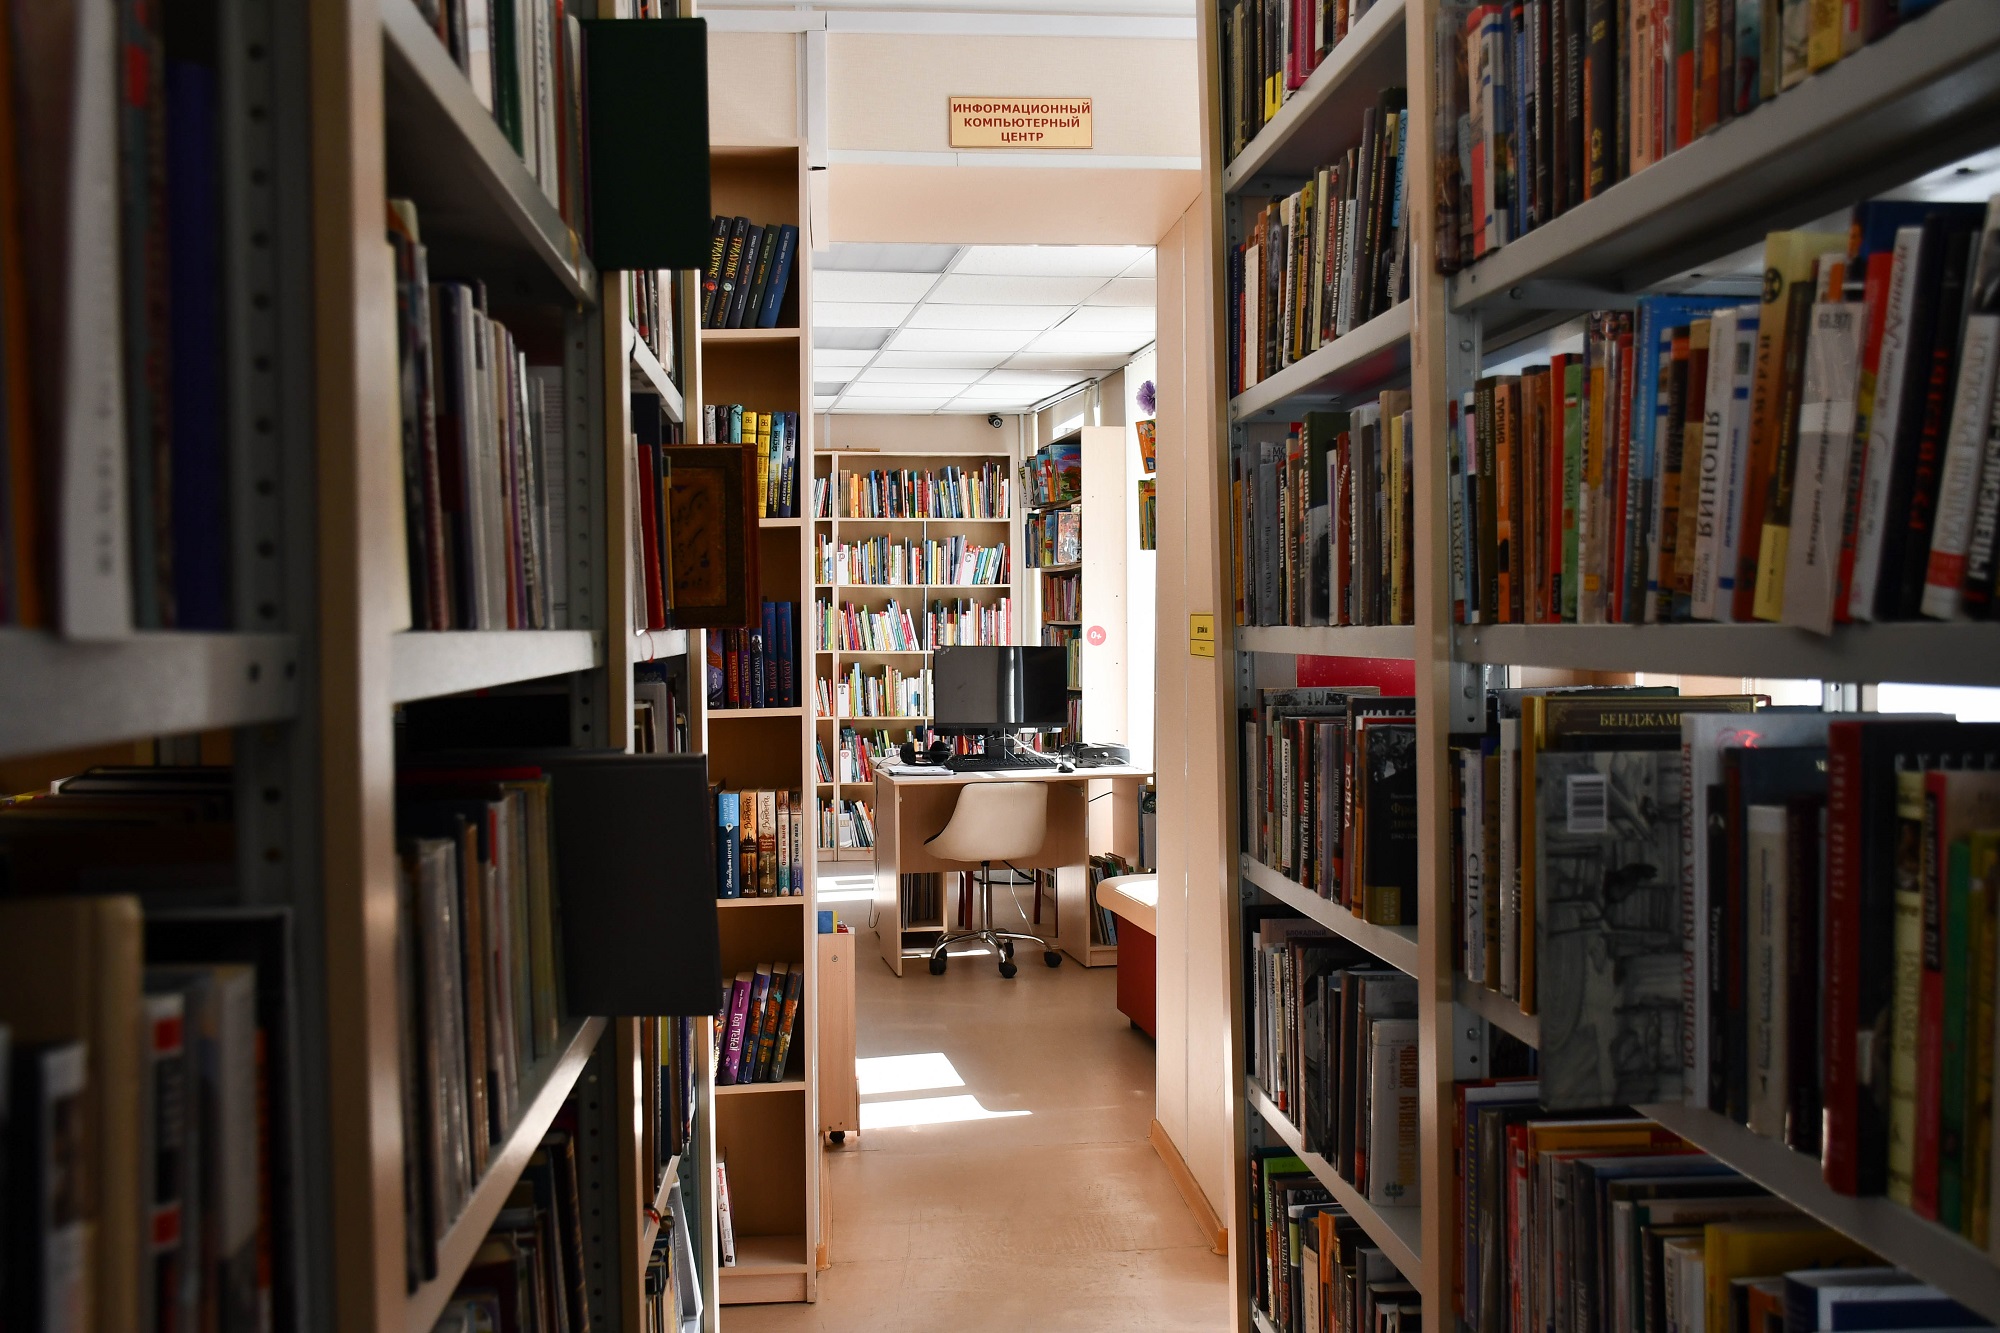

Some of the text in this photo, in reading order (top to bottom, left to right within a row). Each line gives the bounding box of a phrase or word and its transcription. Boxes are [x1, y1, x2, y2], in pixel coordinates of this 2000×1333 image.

[953, 102, 1091, 115] ИНФОРМАЦИОННЫЙ
[963, 116, 1080, 128] КОМПЬЮТЕРНЫЙ
[1001, 132, 1044, 143] ЦЕНТР
[1496, 396, 1506, 445] ТУРЦИЯ
[1565, 454, 1574, 502] ИРАН
[1698, 411, 1719, 538] ЯПОНИЯ
[1290, 536, 1298, 567] 1918
[1090, 631, 1102, 641] 0+
[1468, 852, 1480, 919] США
[1680, 742, 1695, 1070] БОЛЬШАЯ КНИГА СВАДЬБЫ
[732, 1013, 743, 1027] Год
[729, 1028, 741, 1052] Теней
[1399, 1045, 1418, 1089] ЖИЗНЬ
